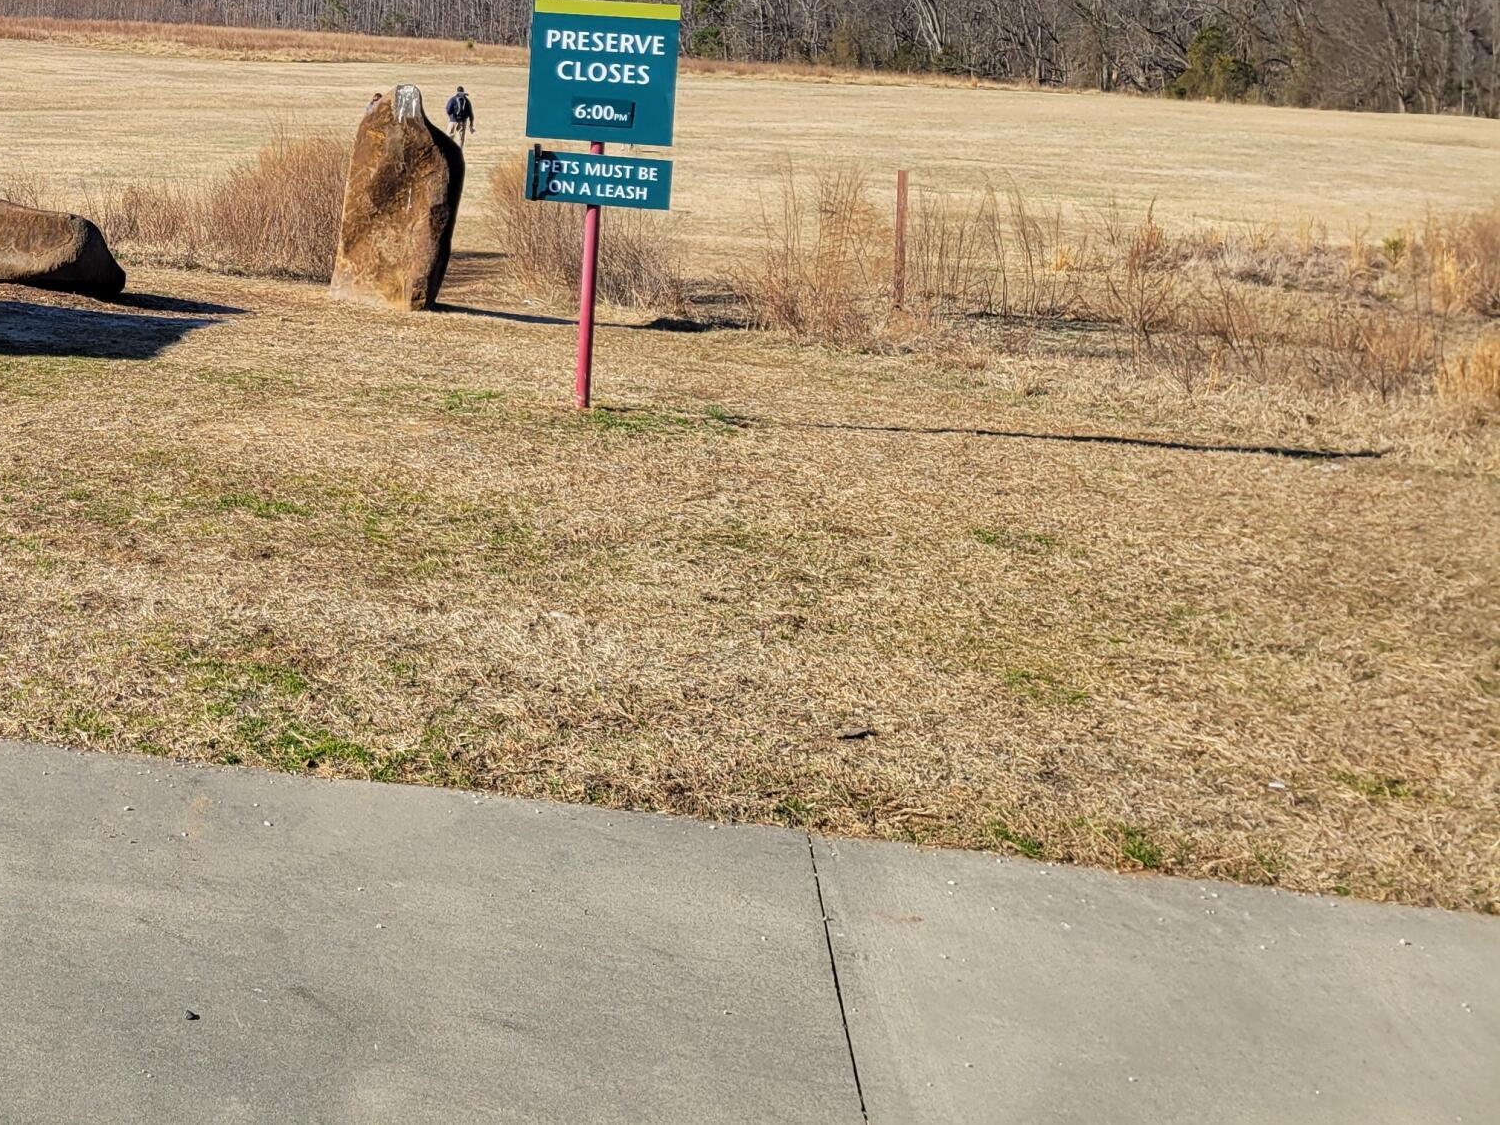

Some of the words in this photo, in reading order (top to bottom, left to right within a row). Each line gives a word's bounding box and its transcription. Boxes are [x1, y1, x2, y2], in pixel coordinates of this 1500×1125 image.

[546, 29, 665, 55] PRESERVE
[557, 60, 650, 85] CLOSES
[541, 159, 580, 176] PETS
[585, 162, 634, 179] MUST
[638, 167, 658, 181] BE
[549, 179, 575, 195] ON
[579, 182, 591, 196] A
[596, 183, 648, 200] LEASH
